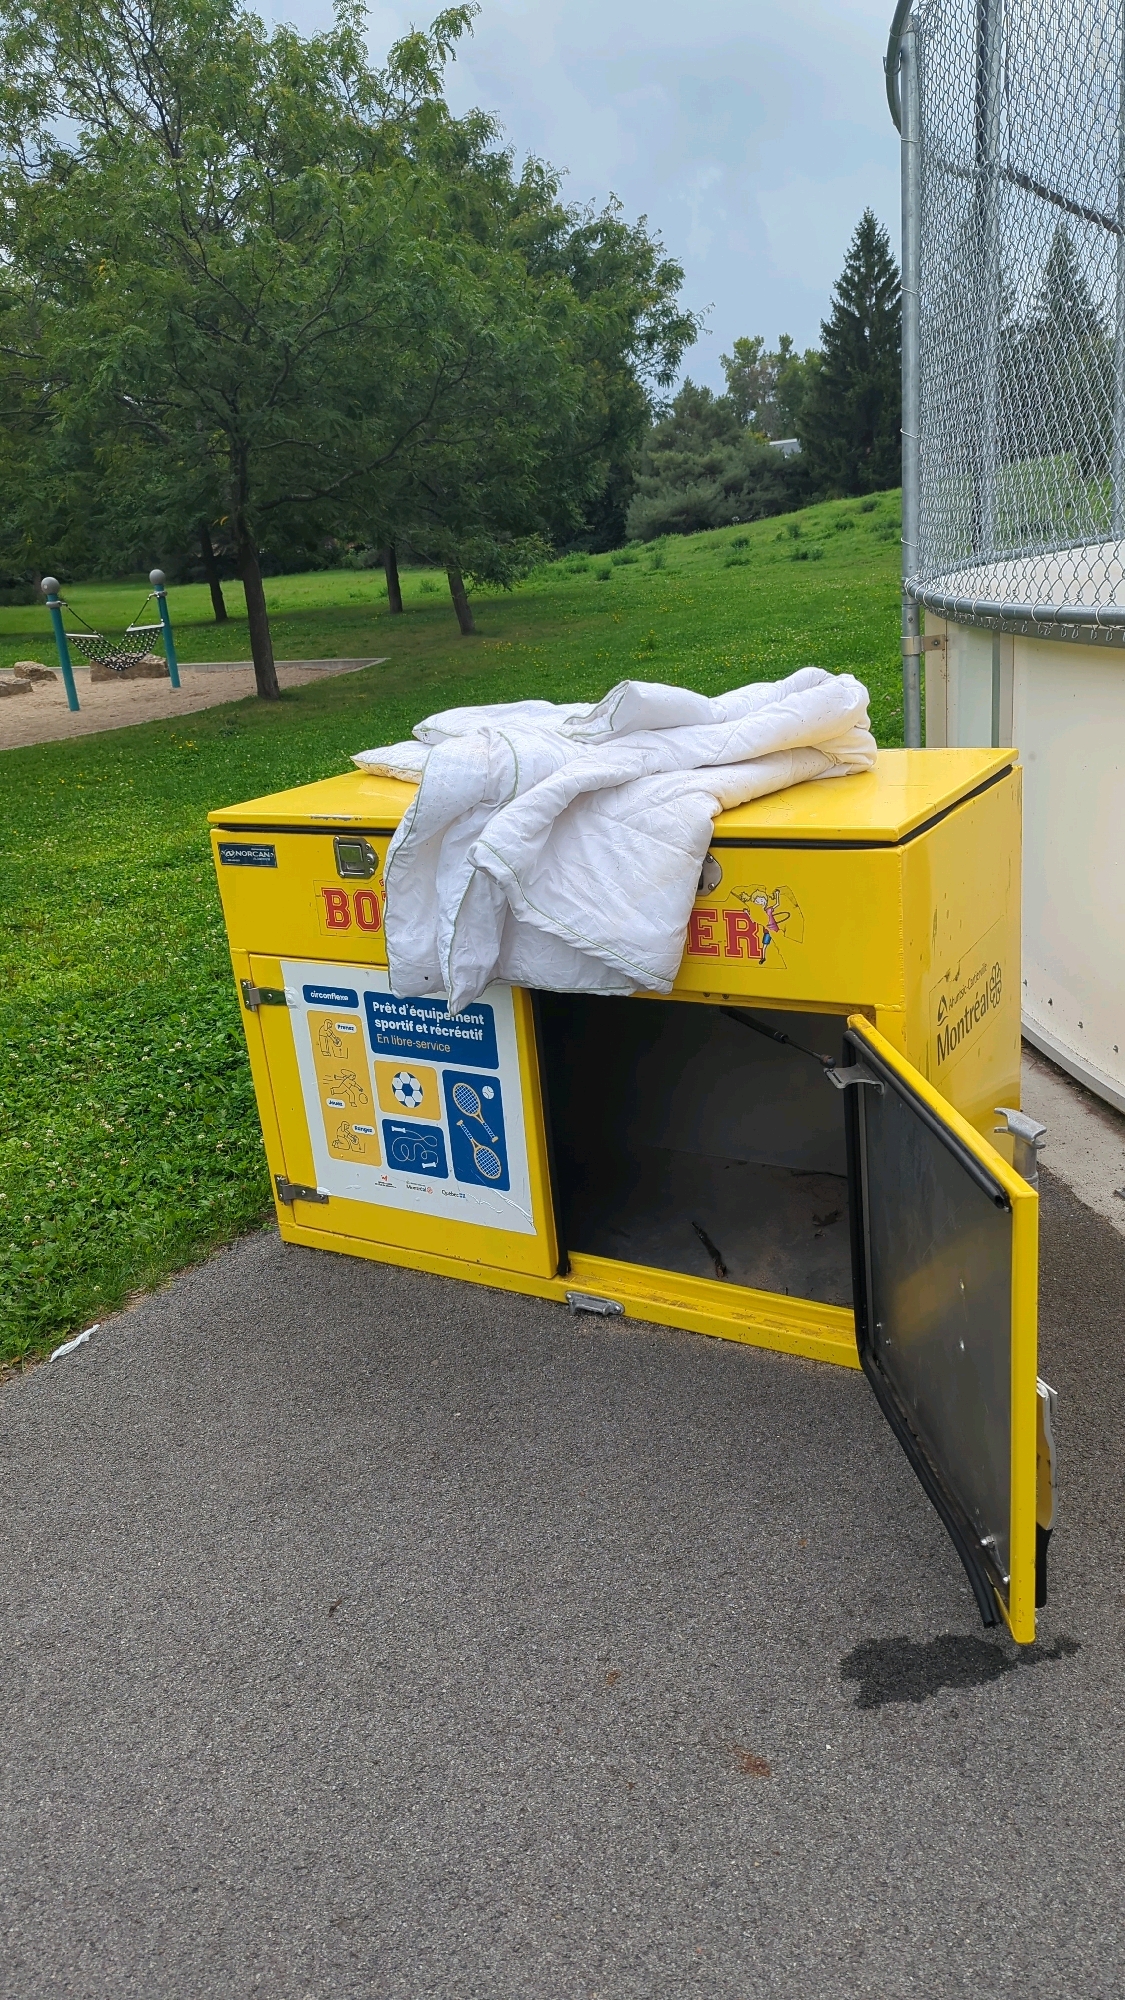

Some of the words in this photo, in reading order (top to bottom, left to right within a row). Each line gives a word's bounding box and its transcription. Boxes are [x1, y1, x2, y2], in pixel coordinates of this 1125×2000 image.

[235, 850, 270, 858] NORCAN
[321, 878, 386, 932] BO
[687, 908, 763, 960] ER
[310, 990, 349, 1001] circonflexe
[372, 1001, 397, 1015] Prêt
[374, 1019, 414, 1032] sportif
[415, 1023, 428, 1034] et
[429, 1024, 484, 1041] récréatif
[936, 980, 989, 1067] Montréal
[376, 1033, 390, 1045] En
[391, 1035, 451, 1053] libre-service
